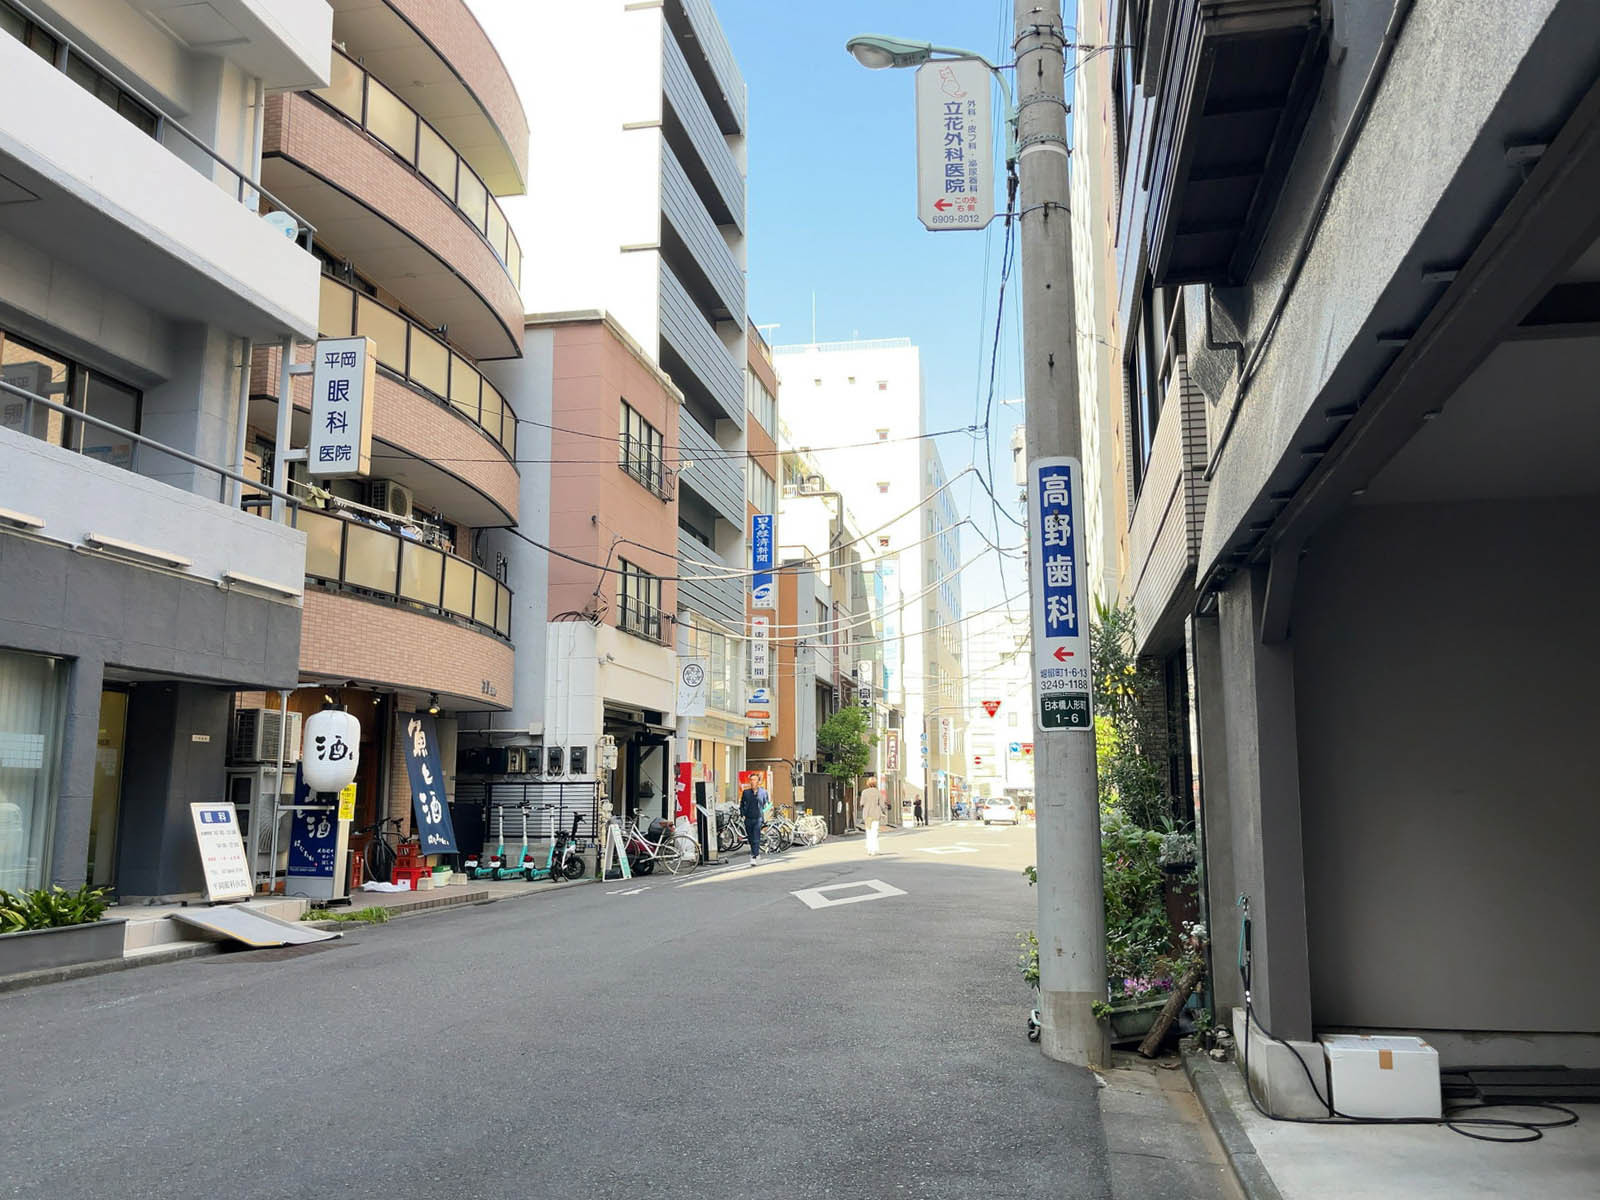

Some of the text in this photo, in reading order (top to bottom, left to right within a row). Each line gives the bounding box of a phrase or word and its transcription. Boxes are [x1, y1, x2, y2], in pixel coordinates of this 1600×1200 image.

[943, 100, 966, 194] 立花外科医院
[932, 215, 980, 224] 6909-8012
[324, 351, 357, 369] 平岡
[325, 379, 350, 435] 眼科
[319, 444, 352, 462] 医院
[1041, 473, 1076, 630] 高野歯科
[1040, 679, 1088, 690] 3249-1188
[1055, 713, 1080, 724] 1-6
[315, 734, 348, 761] 酒
